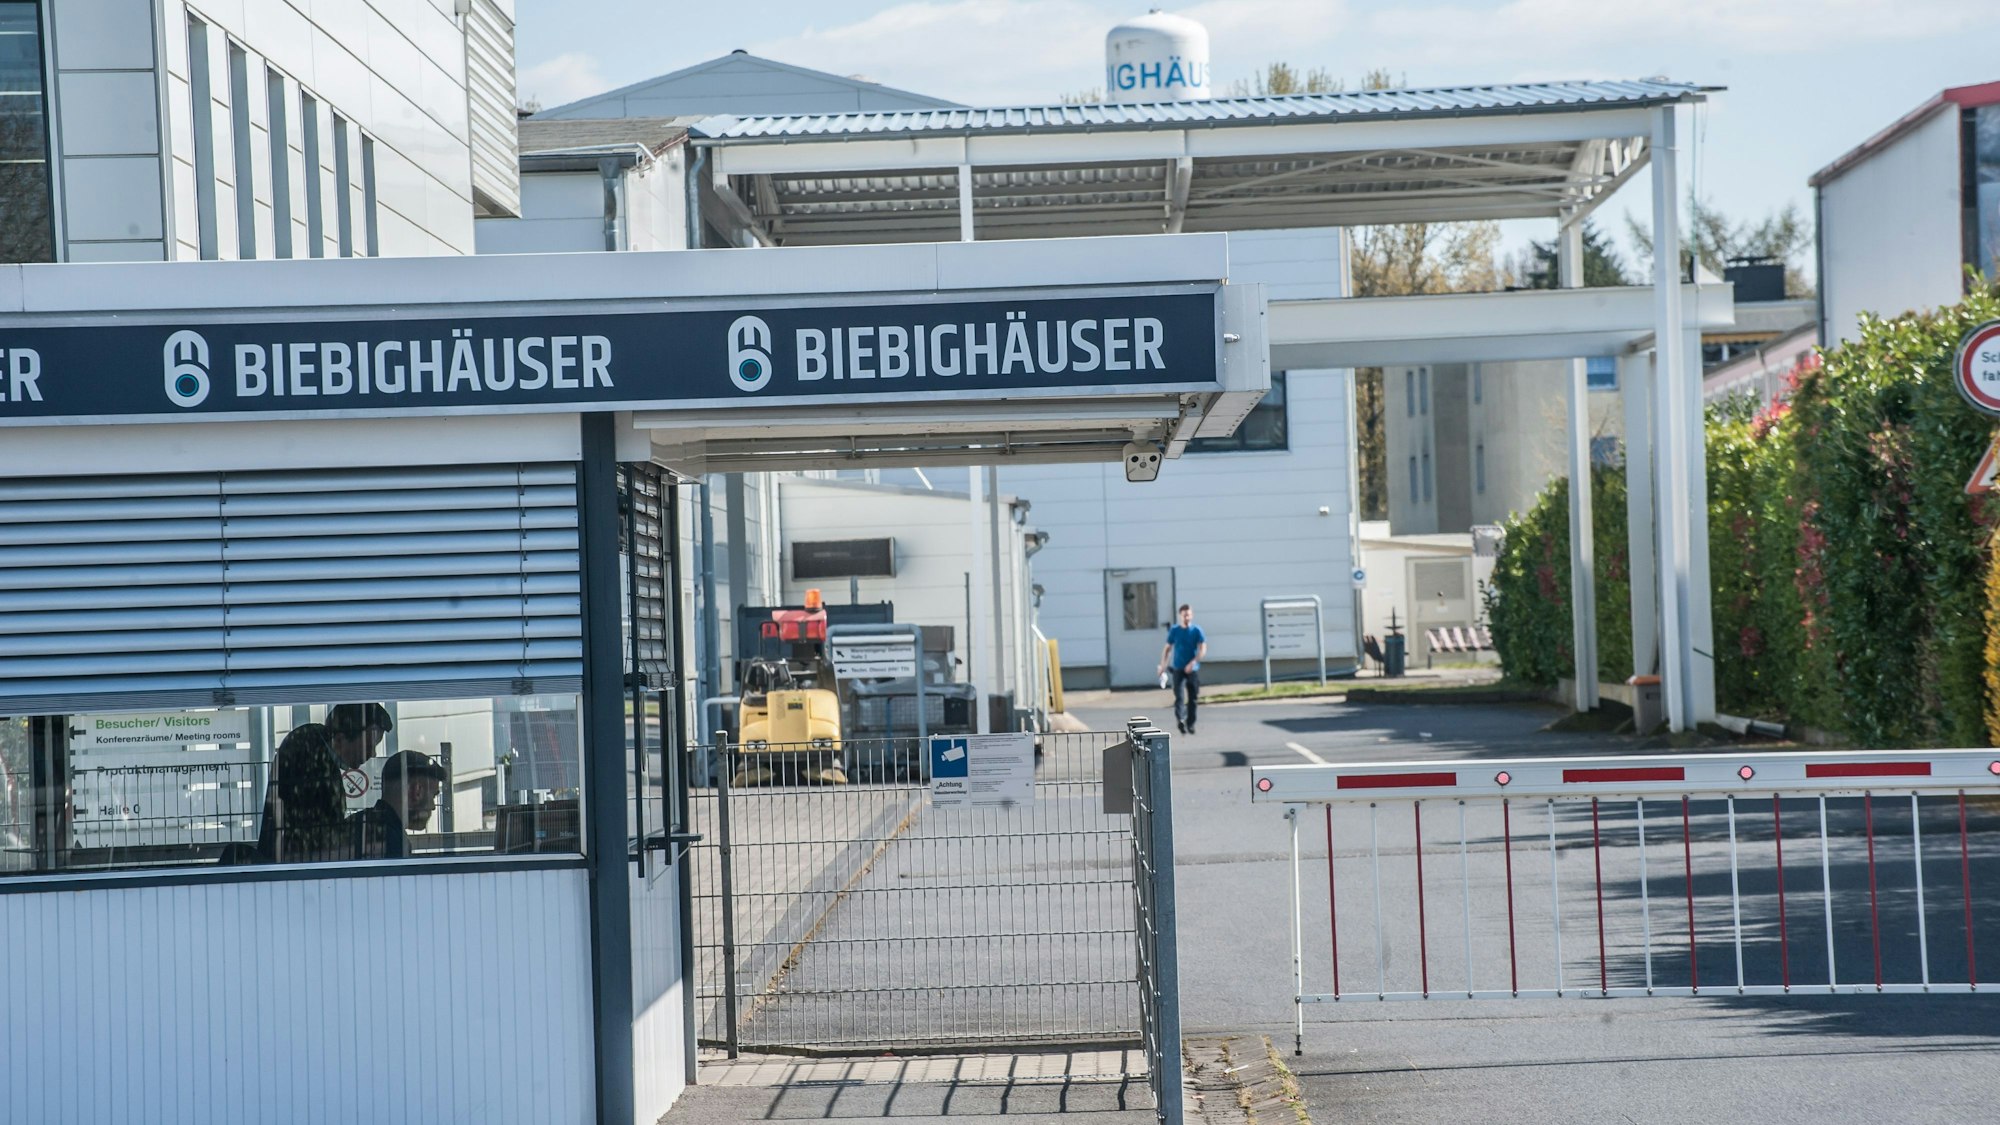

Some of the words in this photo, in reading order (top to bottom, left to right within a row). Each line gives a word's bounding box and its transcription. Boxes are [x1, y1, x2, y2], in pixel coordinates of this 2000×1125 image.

[796, 311, 1166, 381] BIEBIGHÄUSER
[234, 328, 615, 397] BIEBIGHÄUSER
[95, 717, 160, 730] Besucher/
[163, 716, 211, 727] Visitors
[96, 734, 173, 744] Konferenzräume/
[175, 733, 211, 742] Meeting
[213, 732, 241, 740] rooms
[97, 761, 229, 776] Produktmanagement
[100, 805, 130, 816] Halle
